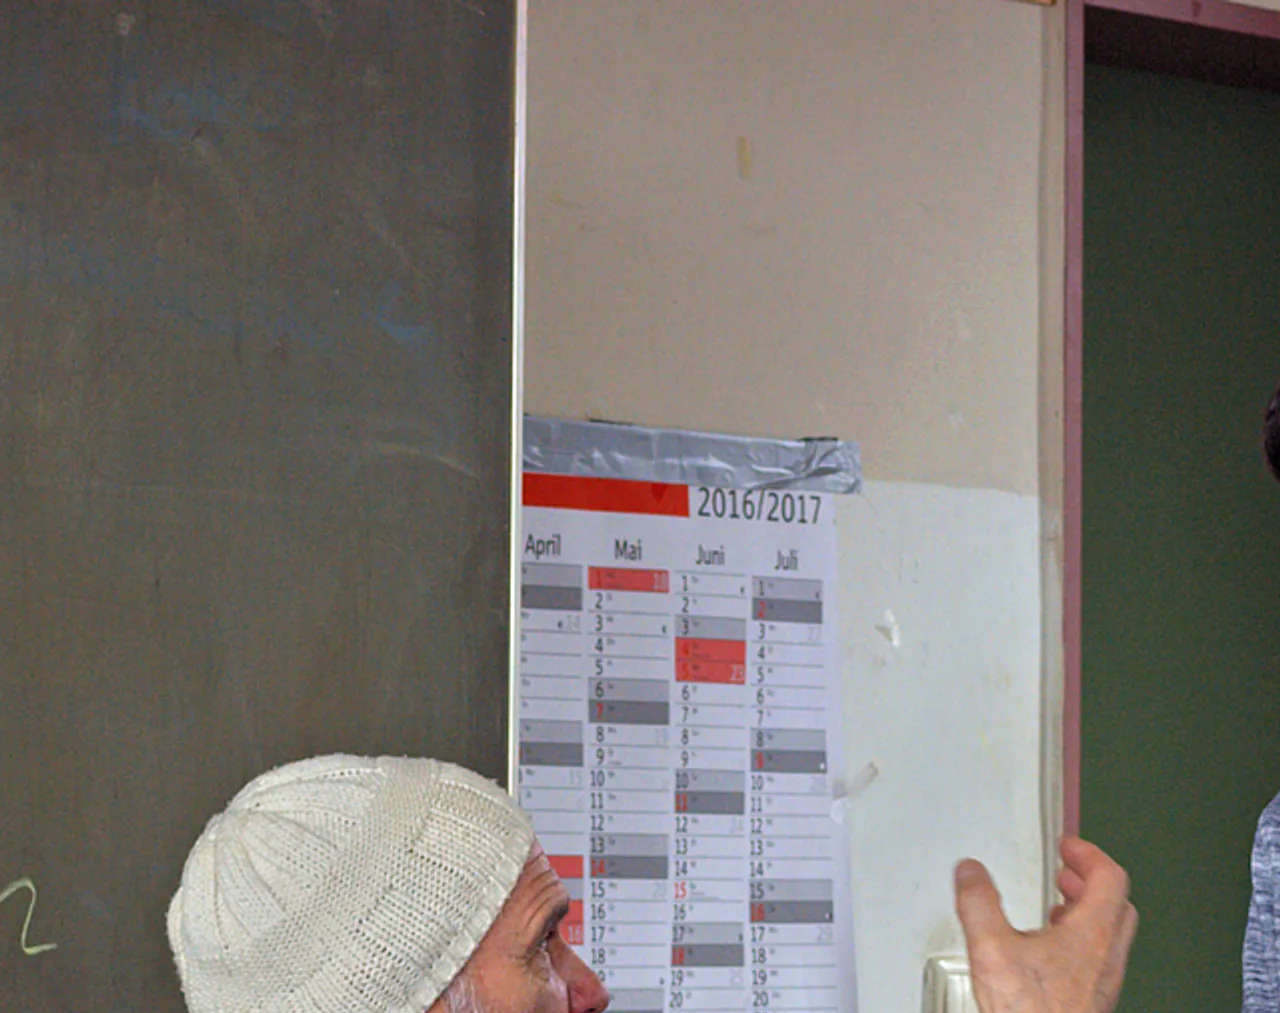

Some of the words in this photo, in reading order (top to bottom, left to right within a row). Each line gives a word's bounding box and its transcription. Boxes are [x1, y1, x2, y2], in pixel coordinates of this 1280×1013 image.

[697, 486, 822, 524] 2016/2017
[524, 533, 561, 560] April
[614, 537, 642, 560] Mai
[695, 544, 725, 565] Juni
[774, 549, 798, 571] Juli
[590, 770, 605, 787] 10
[675, 772, 689, 789] 10
[751, 775, 764, 791] 10
[590, 792, 604, 809] 11
[675, 793, 688, 811] 11
[751, 796, 762, 813] 11
[590, 814, 604, 831] 12
[675, 816, 688, 833] 12
[750, 818, 763, 834] 12
[590, 836, 605, 853] 13
[675, 838, 688, 855] 13
[750, 840, 763, 856] 13
[591, 859, 606, 876] 14
[675, 860, 688, 876] 14
[750, 861, 764, 877] 14
[591, 881, 605, 898] 15
[674, 881, 687, 899] 15
[750, 882, 765, 899] 15
[591, 904, 605, 920] 16
[673, 904, 687, 920] 16
[751, 903, 766, 922] 16
[591, 926, 605, 943] 17
[672, 926, 685, 942] 17
[751, 926, 765, 943] 17
[591, 948, 606, 965] 18
[752, 948, 767, 964] 18
[671, 970, 684, 986] 19
[752, 970, 767, 986] 19
[670, 992, 683, 1008] 20
[753, 991, 769, 1007] 20
